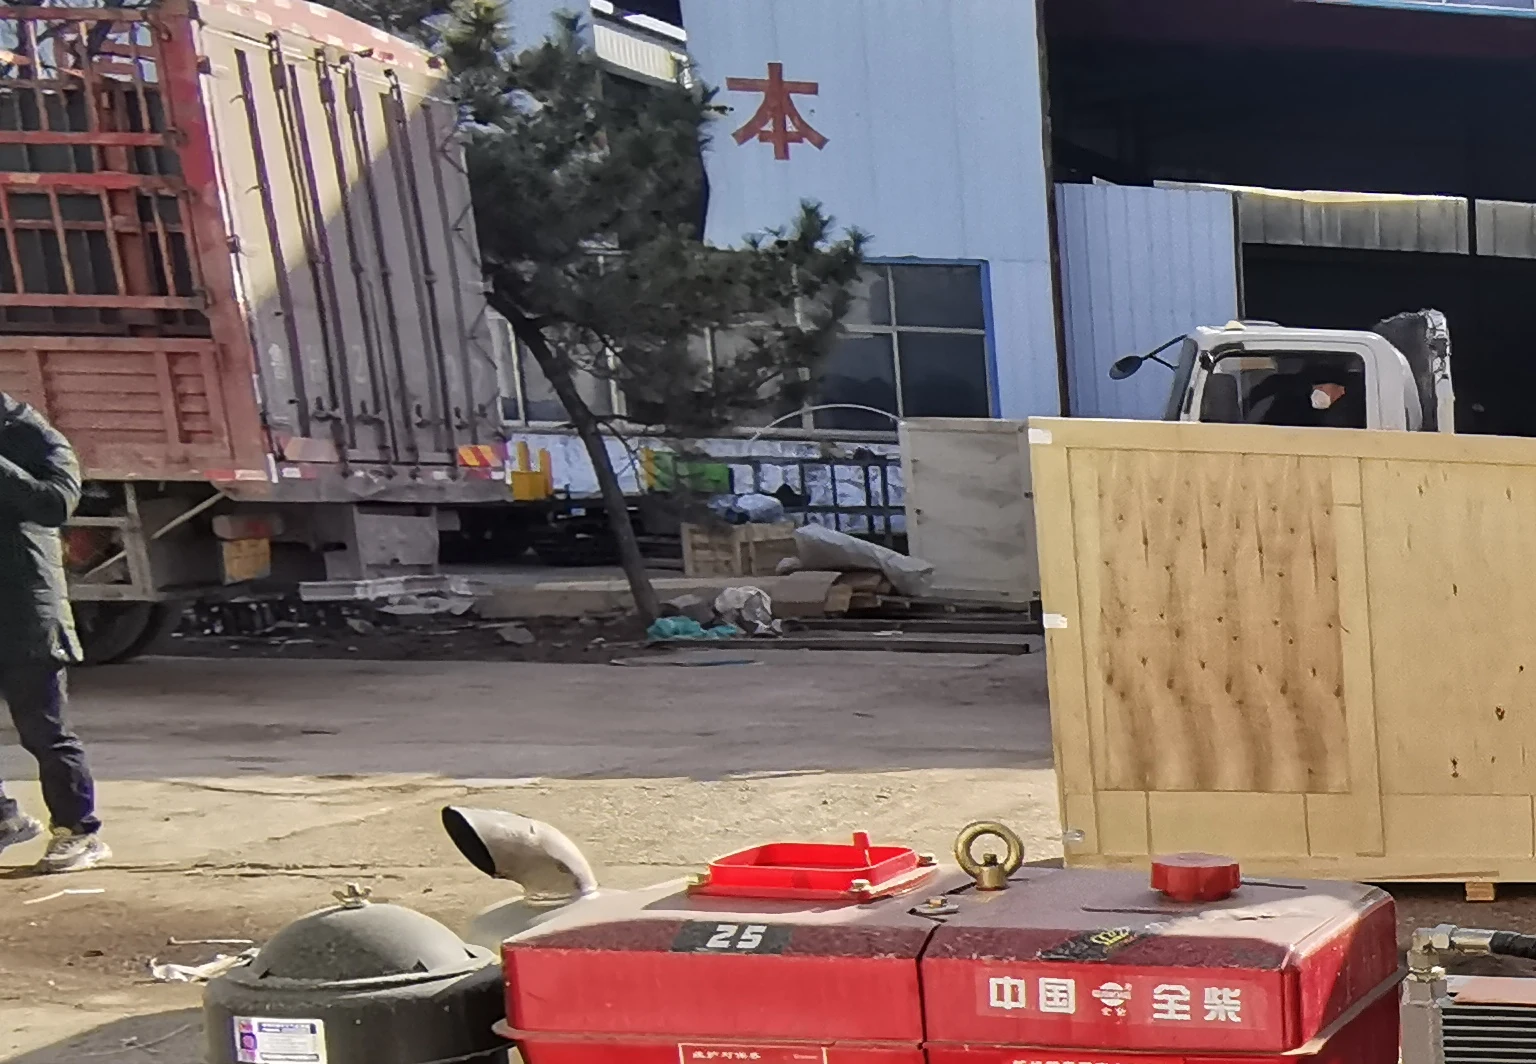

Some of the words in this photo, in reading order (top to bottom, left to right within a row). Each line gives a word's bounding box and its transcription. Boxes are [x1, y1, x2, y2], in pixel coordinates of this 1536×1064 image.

[725, 62, 830, 161] 本
[705, 924, 768, 949] 25
[989, 976, 1076, 1014] 中国
[1152, 984, 1242, 1022] 全柴
